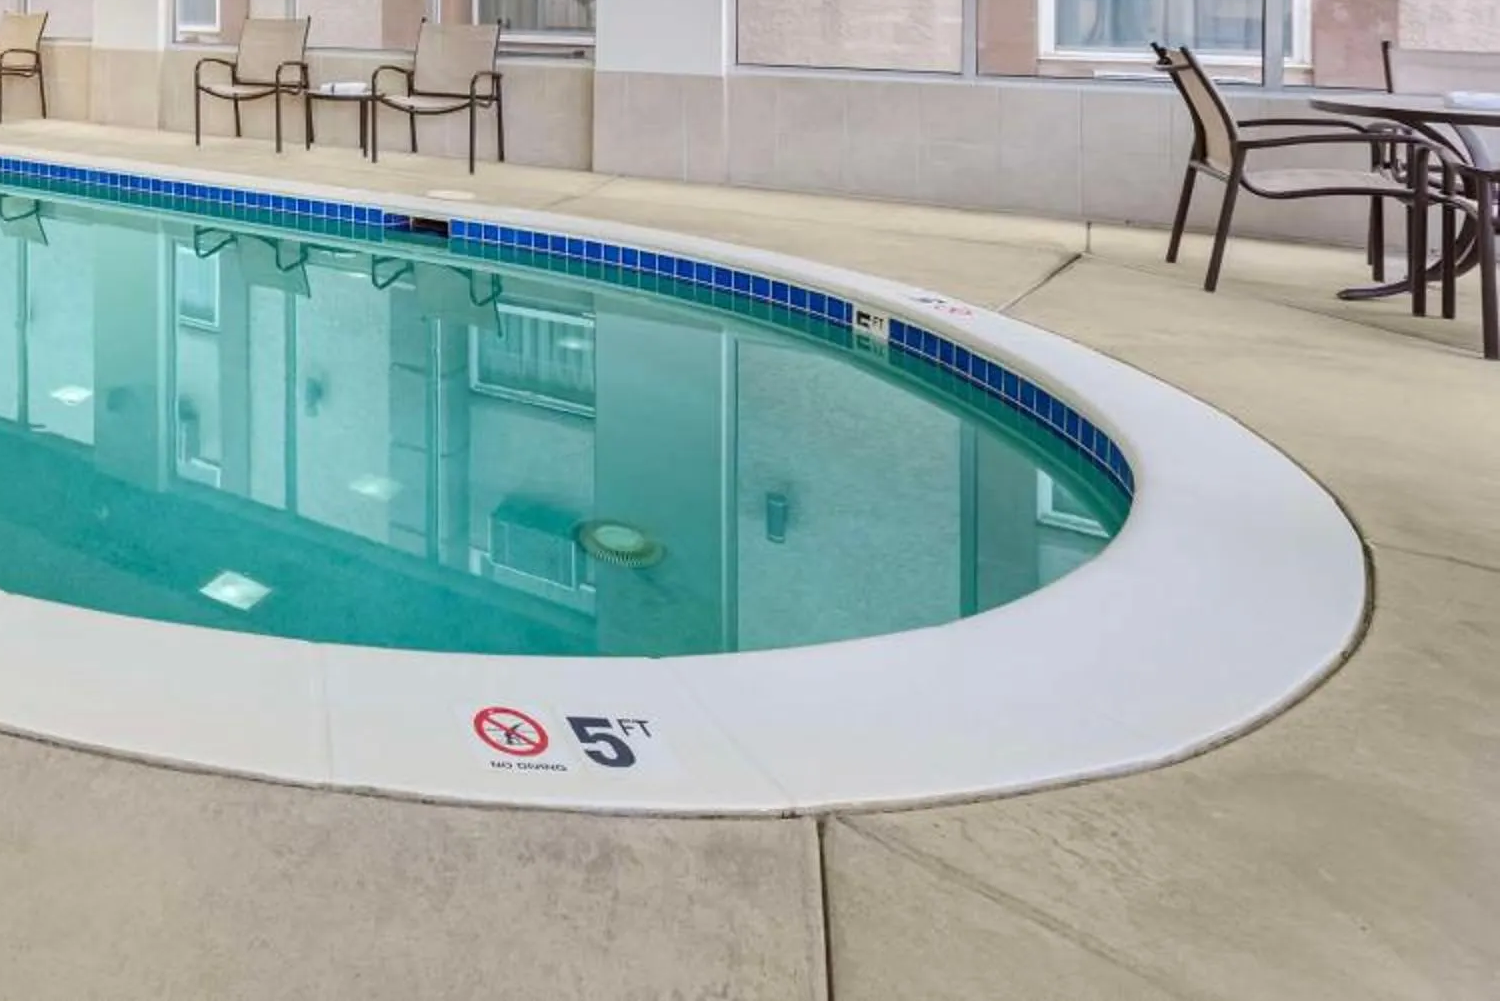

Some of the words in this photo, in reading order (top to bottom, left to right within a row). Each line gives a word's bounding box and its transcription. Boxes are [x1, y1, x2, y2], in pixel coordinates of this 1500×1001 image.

[566, 716, 637, 768] 5
[617, 718, 652, 739] FT
[489, 760, 513, 770] NO
[516, 762, 568, 772] DIVING
